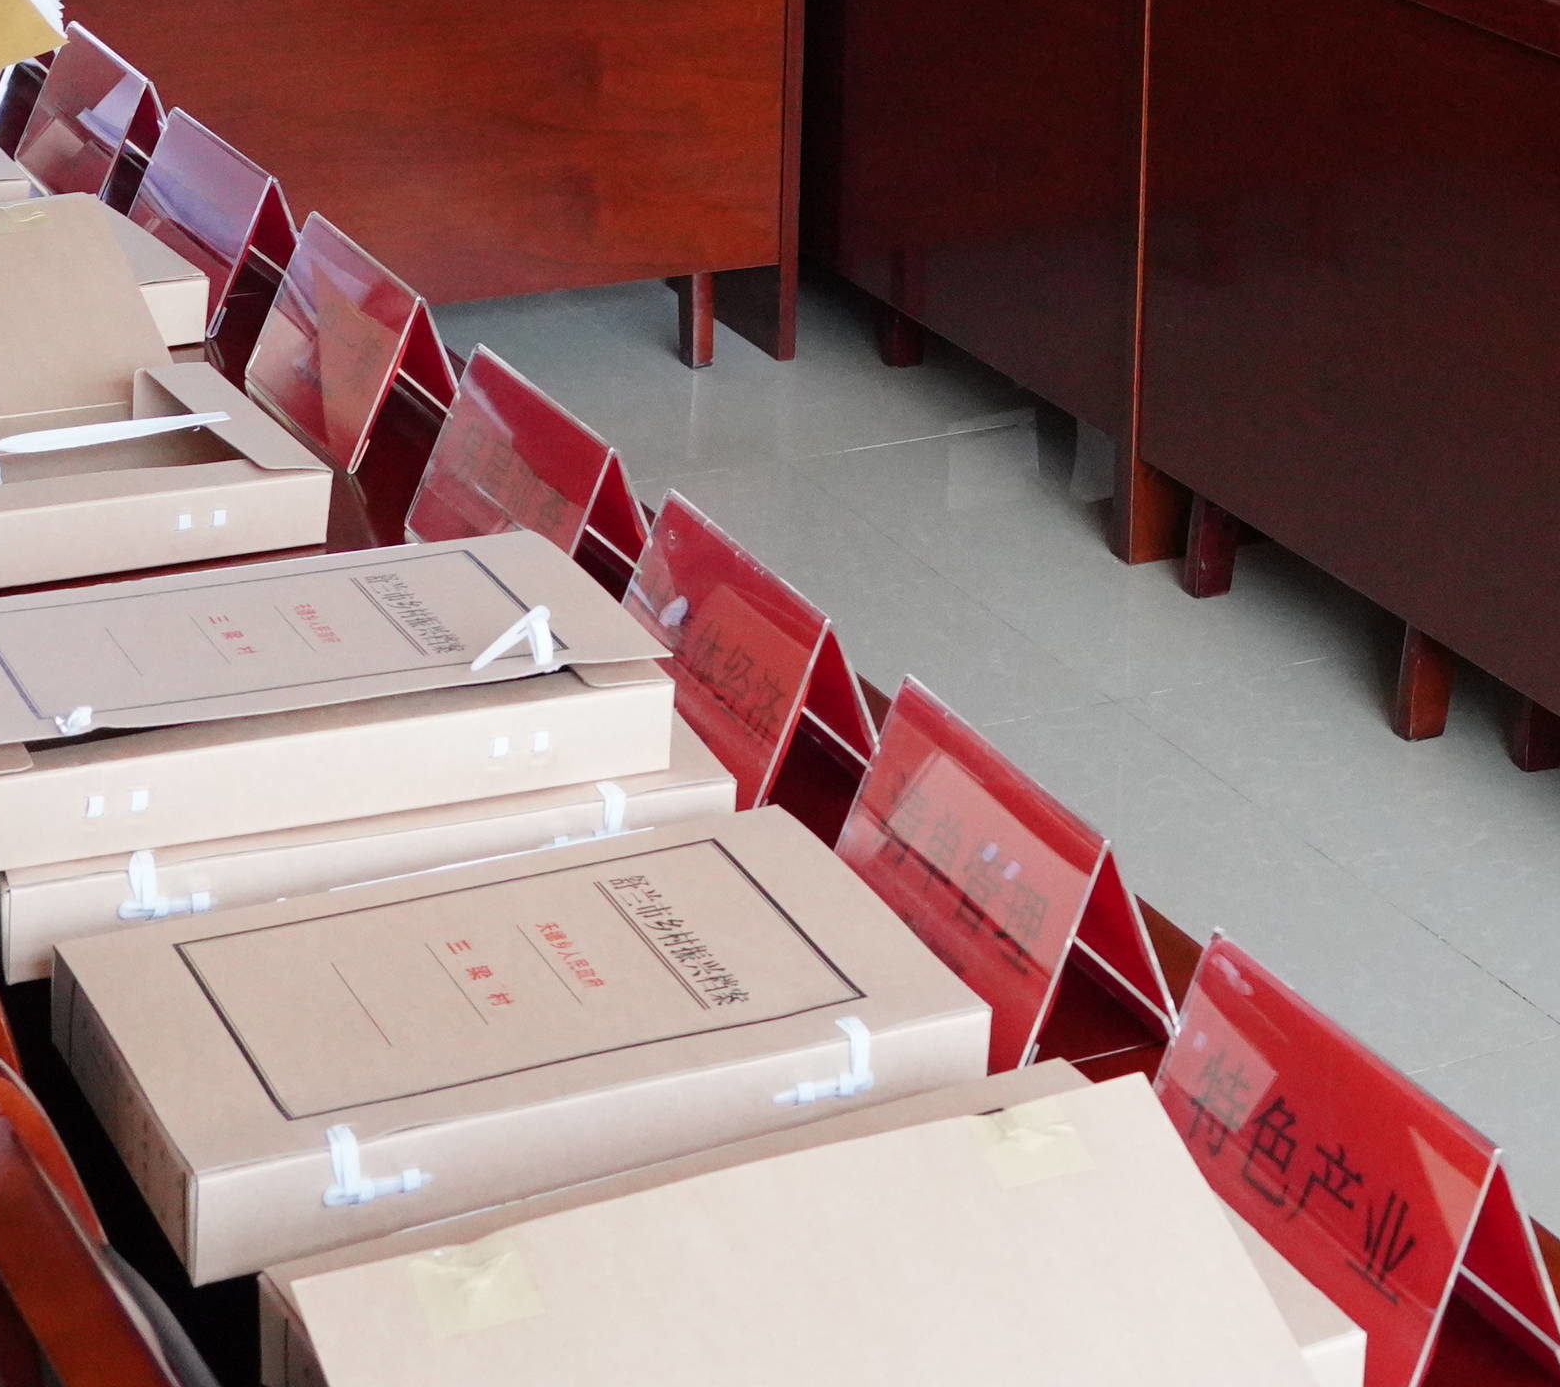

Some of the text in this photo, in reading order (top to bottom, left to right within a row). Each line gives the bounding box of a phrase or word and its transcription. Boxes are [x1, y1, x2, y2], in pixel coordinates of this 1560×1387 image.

[445, 939, 514, 1007] 三梁村
[536, 922, 607, 988] 天德乡人民政府
[608, 874, 750, 1007] 舒兰市乡村振兴档案
[1185, 1042, 1419, 1307] 特色产业
